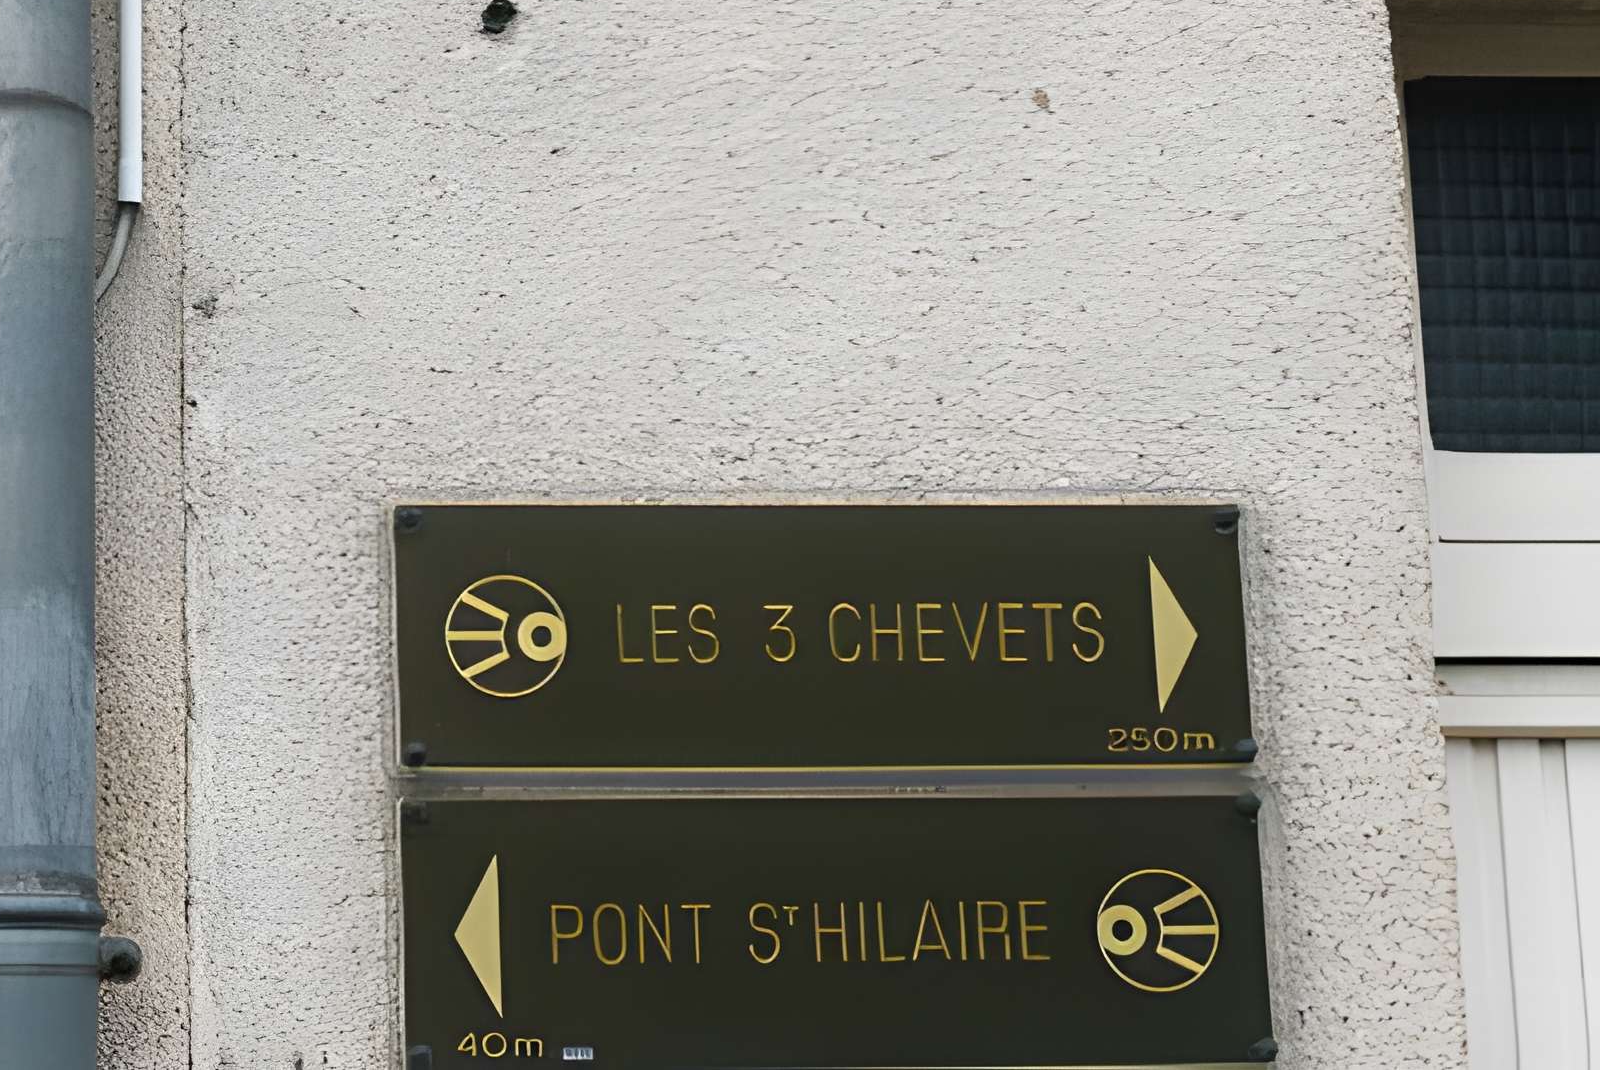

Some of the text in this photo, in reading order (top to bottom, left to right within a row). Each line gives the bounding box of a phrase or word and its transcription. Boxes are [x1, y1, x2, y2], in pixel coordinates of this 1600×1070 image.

[615, 600, 1105, 666] LES 3 CHEVETS
[1106, 726, 1216, 754] 250m
[548, 901, 712, 968] PONT
[814, 897, 1050, 963] HILAIRE
[455, 1030, 545, 1059] 40m
